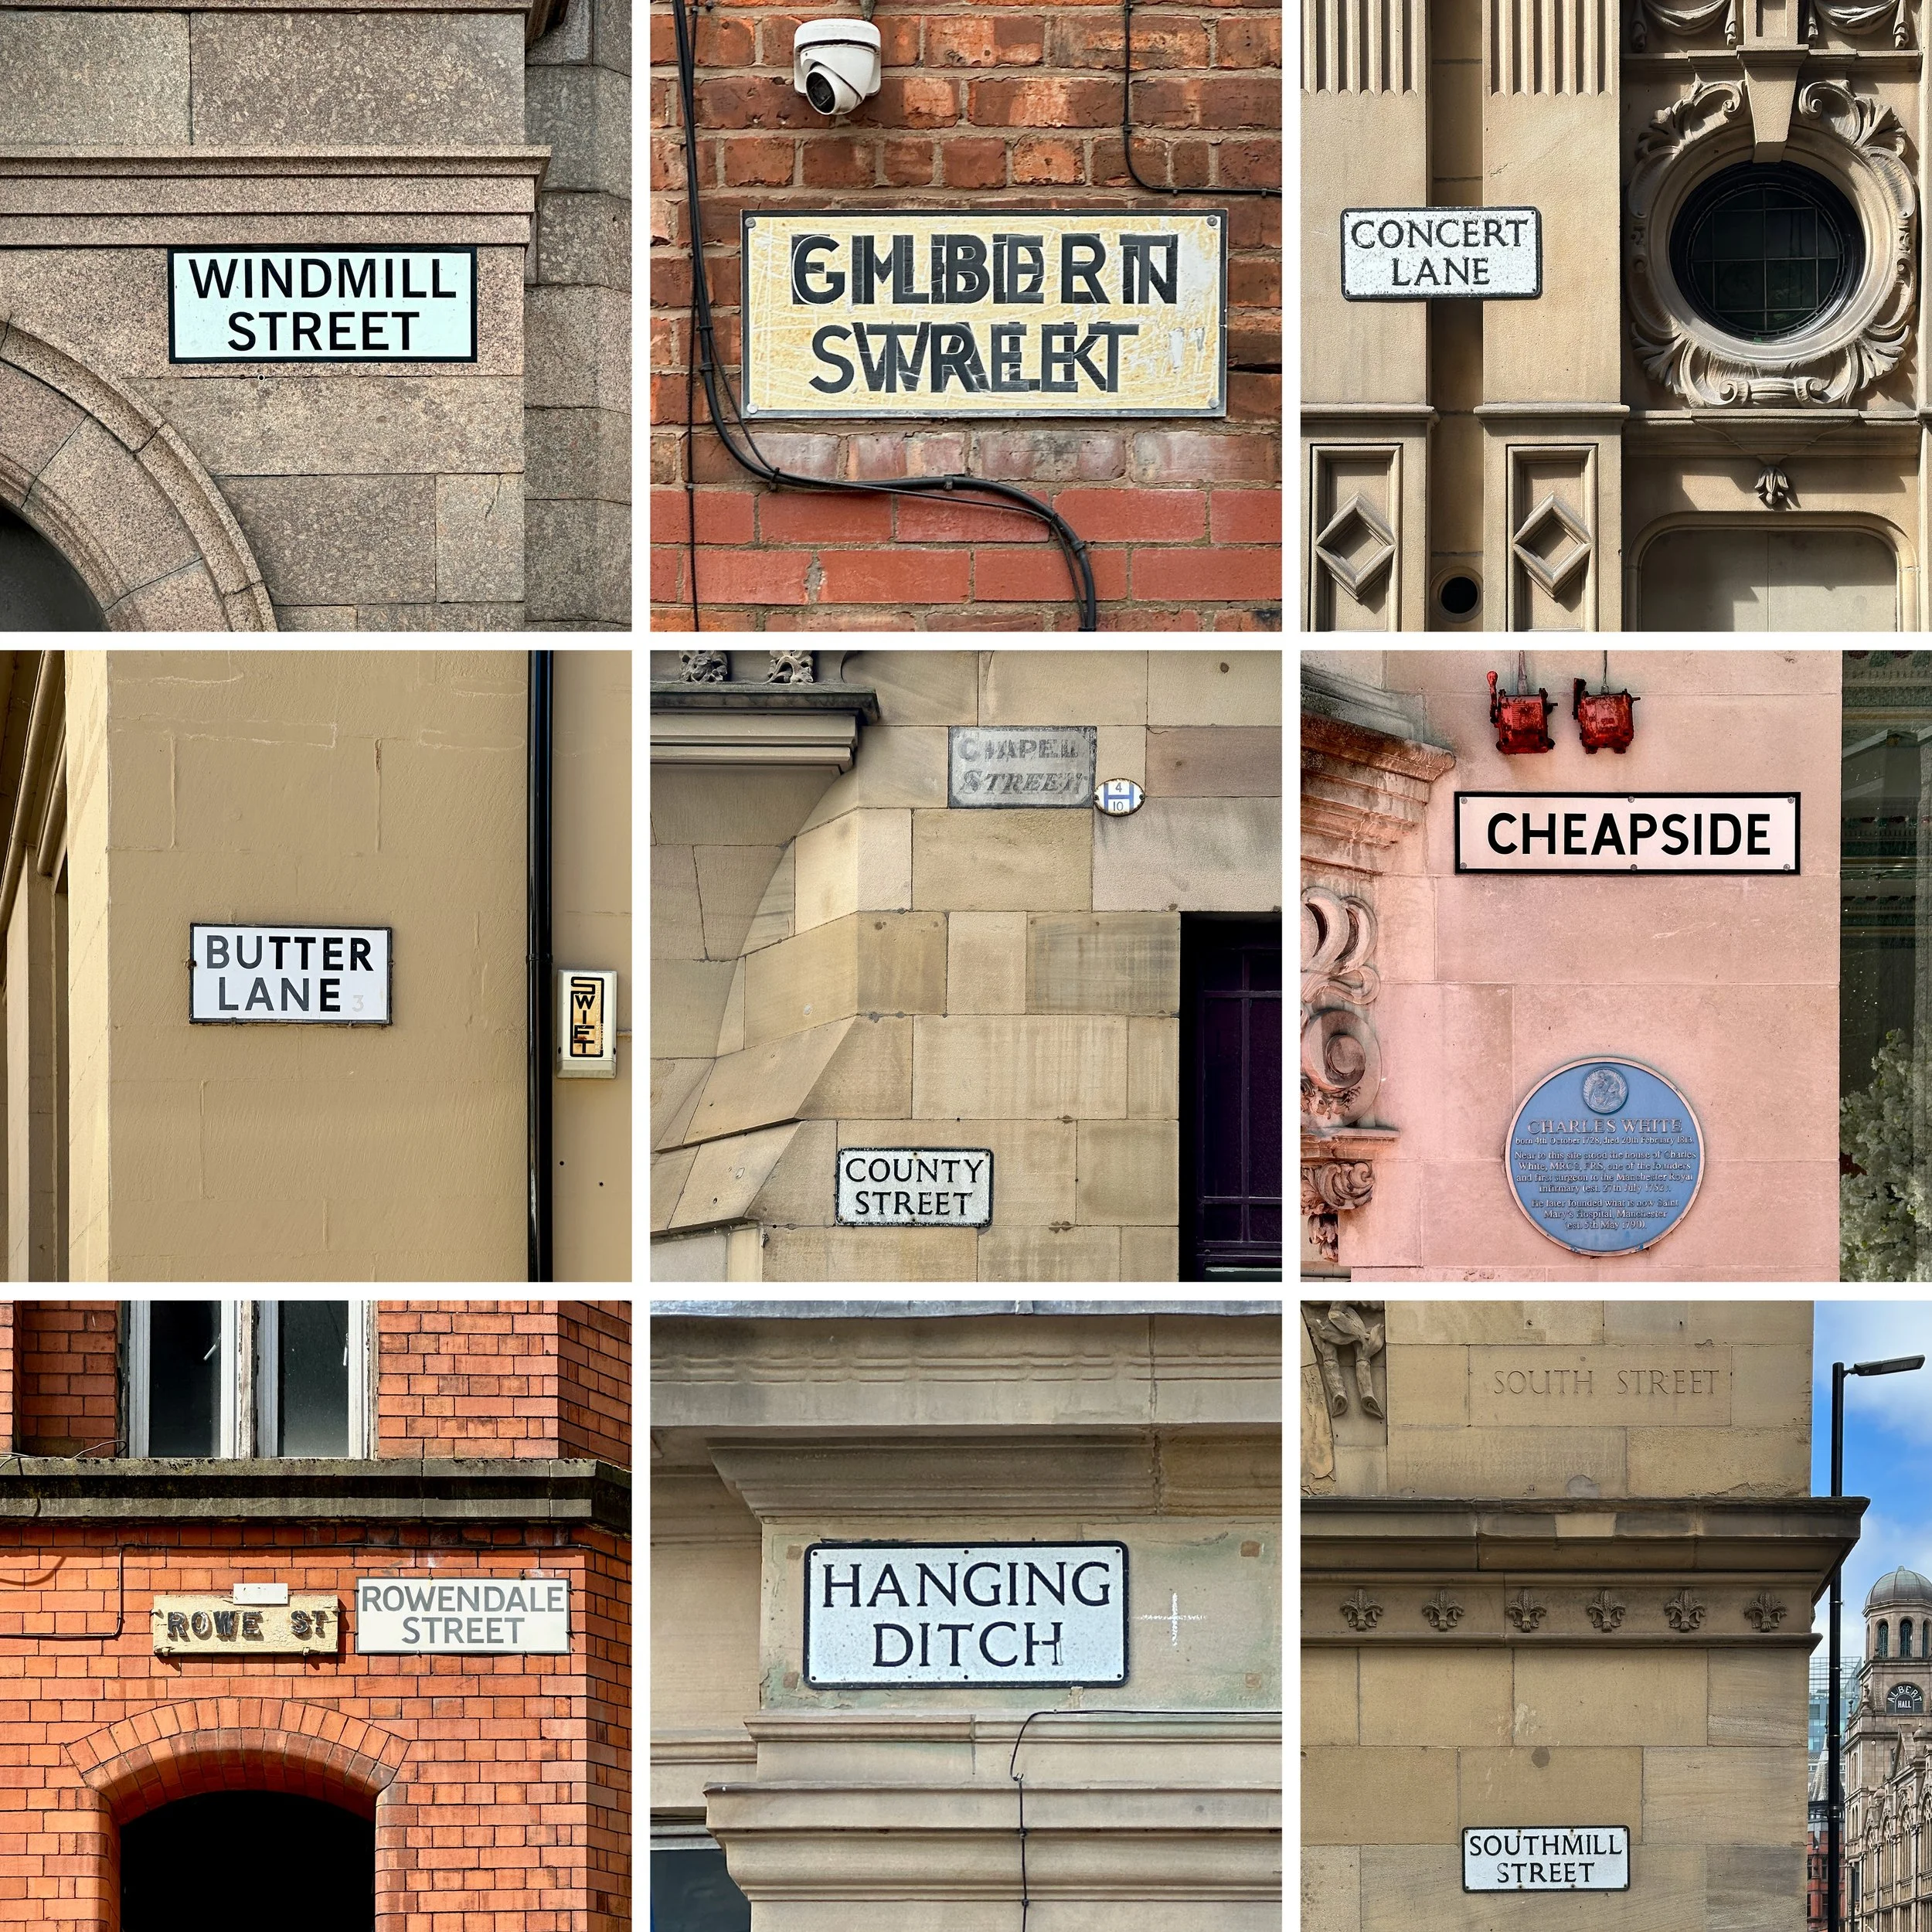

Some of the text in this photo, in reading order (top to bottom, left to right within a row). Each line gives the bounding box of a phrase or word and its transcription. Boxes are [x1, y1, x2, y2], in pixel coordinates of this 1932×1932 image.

[1352, 219, 1529, 249] CONCERT
[189, 258, 457, 298] WINDMILL
[1392, 256, 1490, 286] LANE
[228, 311, 420, 351] STREET
[1115, 782, 1122, 792] 4
[1114, 801, 1123, 811] 10
[1488, 813, 1770, 855] CHEAPSIDE
[206, 935, 373, 971] BUTTER
[219, 977, 364, 1012] LANE 3
[570, 977, 596, 1053] SWIFT
[1528, 1118, 1682, 1134] CHARLES WHITE
[1641, 1136, 1675, 1145] February
[1515, 1151, 1536, 1159] Near
[1548, 1151, 1564, 1159] this
[1584, 1151, 1607, 1159] stood
[1664, 1150, 1696, 1158] Charles
[845, 1158, 984, 1182] COUNTY
[1516, 1173, 1532, 1182] and
[1535, 1173, 1553, 1182] first
[1554, 1174, 1588, 1183] surgeon
[1617, 1173, 1667, 1182] Manchester
[1669, 1172, 1693, 1183] Royal
[1519, 1162, 1548, 1172] White,
[1625, 1162, 1635, 1170] of
[1637, 1162, 1651, 1170] the
[1653, 1162, 1691, 1170] founders
[1602, 1184, 1621, 1192] 27th
[1624, 1184, 1642, 1194] July
[855, 1191, 973, 1216] STREET
[1532, 1199, 1544, 1207] He
[1546, 1199, 1566, 1207] later
[1568, 1199, 1603, 1207] founded
[1617, 1209, 1668, 1218] Manchester
[1600, 1220, 1620, 1230] May
[1494, 1370, 1719, 1394] SOUTH STREET
[822, 1562, 1111, 1607] HANGING
[362, 1586, 565, 1612] ROWENDALE
[168, 1611, 261, 1637] ROWE
[401, 1617, 525, 1644] STREET
[872, 1621, 1063, 1667] DITCH
[1887, 1685, 1922, 1702] ALBERT
[1470, 1835, 1623, 1855] SOUTHMILL
[1497, 1862, 1595, 1883] STREET
